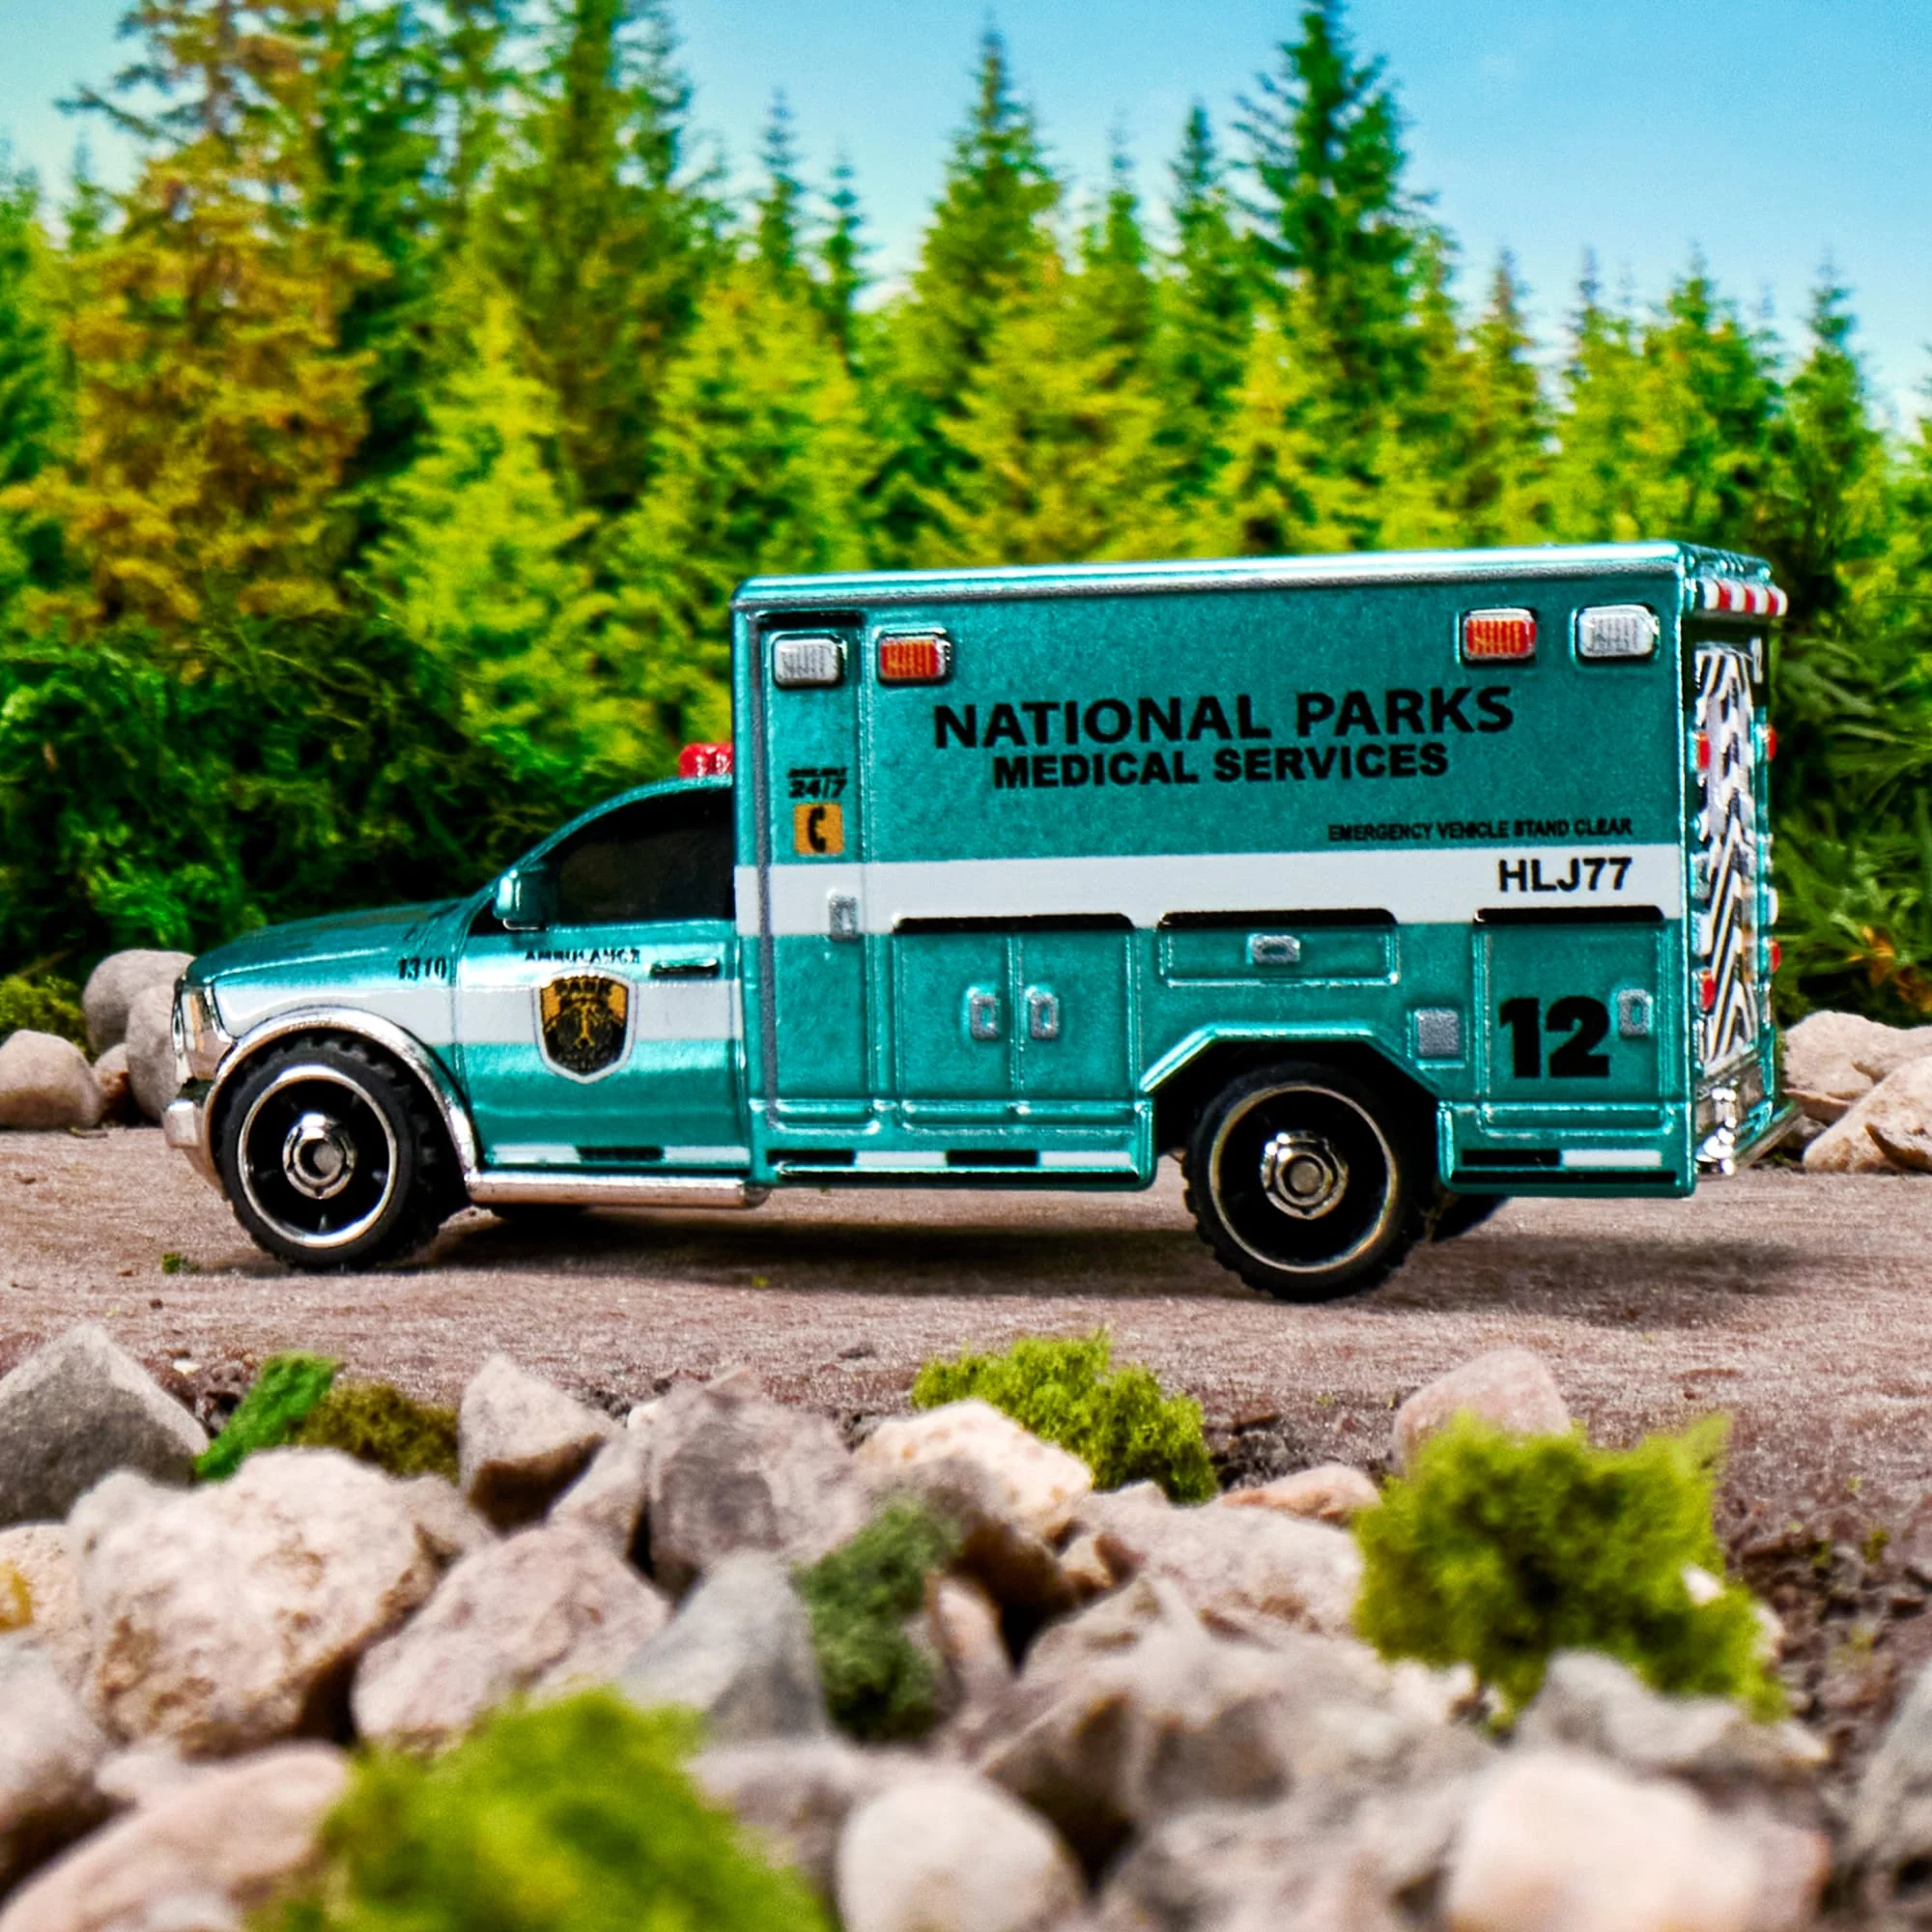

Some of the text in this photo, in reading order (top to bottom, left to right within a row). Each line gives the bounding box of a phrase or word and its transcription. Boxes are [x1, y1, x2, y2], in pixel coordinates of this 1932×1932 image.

[933, 686, 1514, 749] NATIONAL PARKS
[993, 742, 1448, 789] MEDICAL SERVICES
[788, 779, 847, 799] 24/7
[1328, 817, 1633, 842] EMERGENCY VEHICLE STAND CLEAR
[1498, 856, 1633, 893] HLJ77
[1498, 995, 1610, 1079] 12
